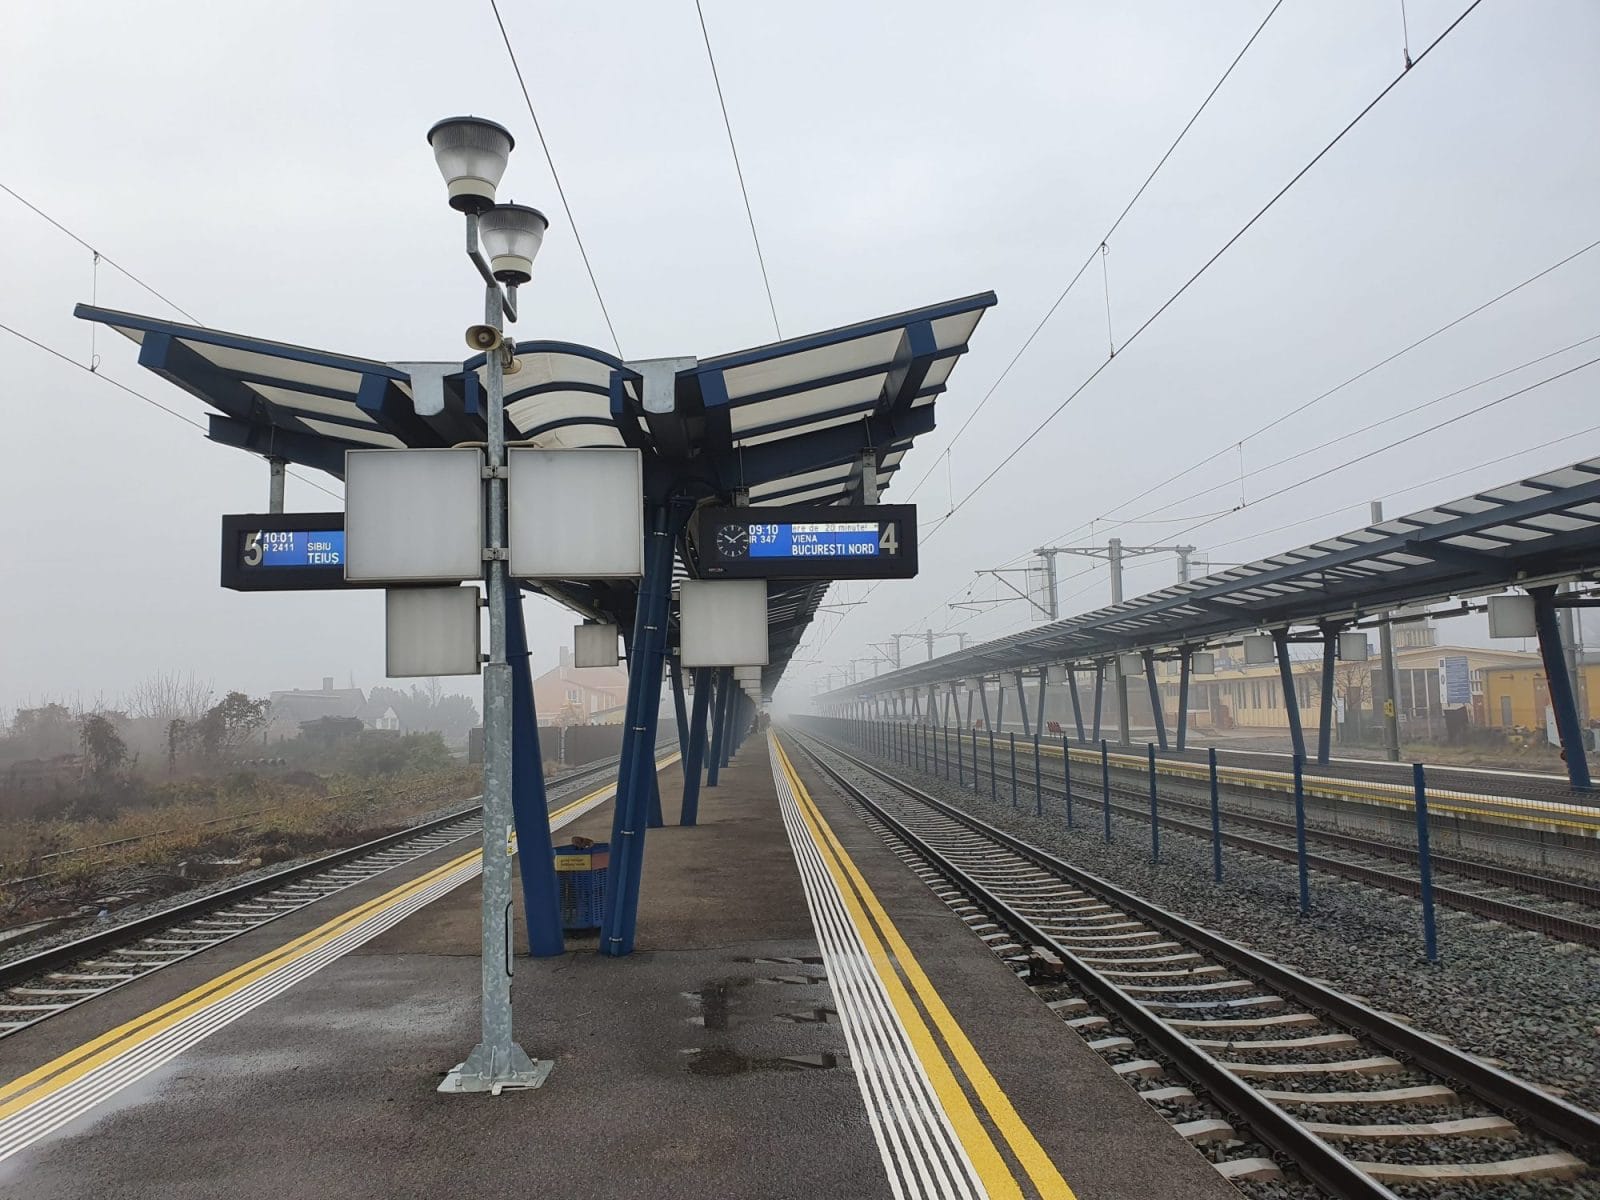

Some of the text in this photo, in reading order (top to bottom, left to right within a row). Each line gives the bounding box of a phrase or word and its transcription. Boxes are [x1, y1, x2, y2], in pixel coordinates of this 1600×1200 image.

[749, 524, 779, 535] 09:10
[263, 532, 294, 543] 10:01
[749, 535, 777, 544] IR 347
[792, 534, 818, 543] VIENA
[879, 522, 899, 555] 4
[244, 532, 263, 566] 5
[272, 543, 295, 552] 2411
[307, 542, 332, 551] SIBIU
[848, 543, 875, 554] NORD
